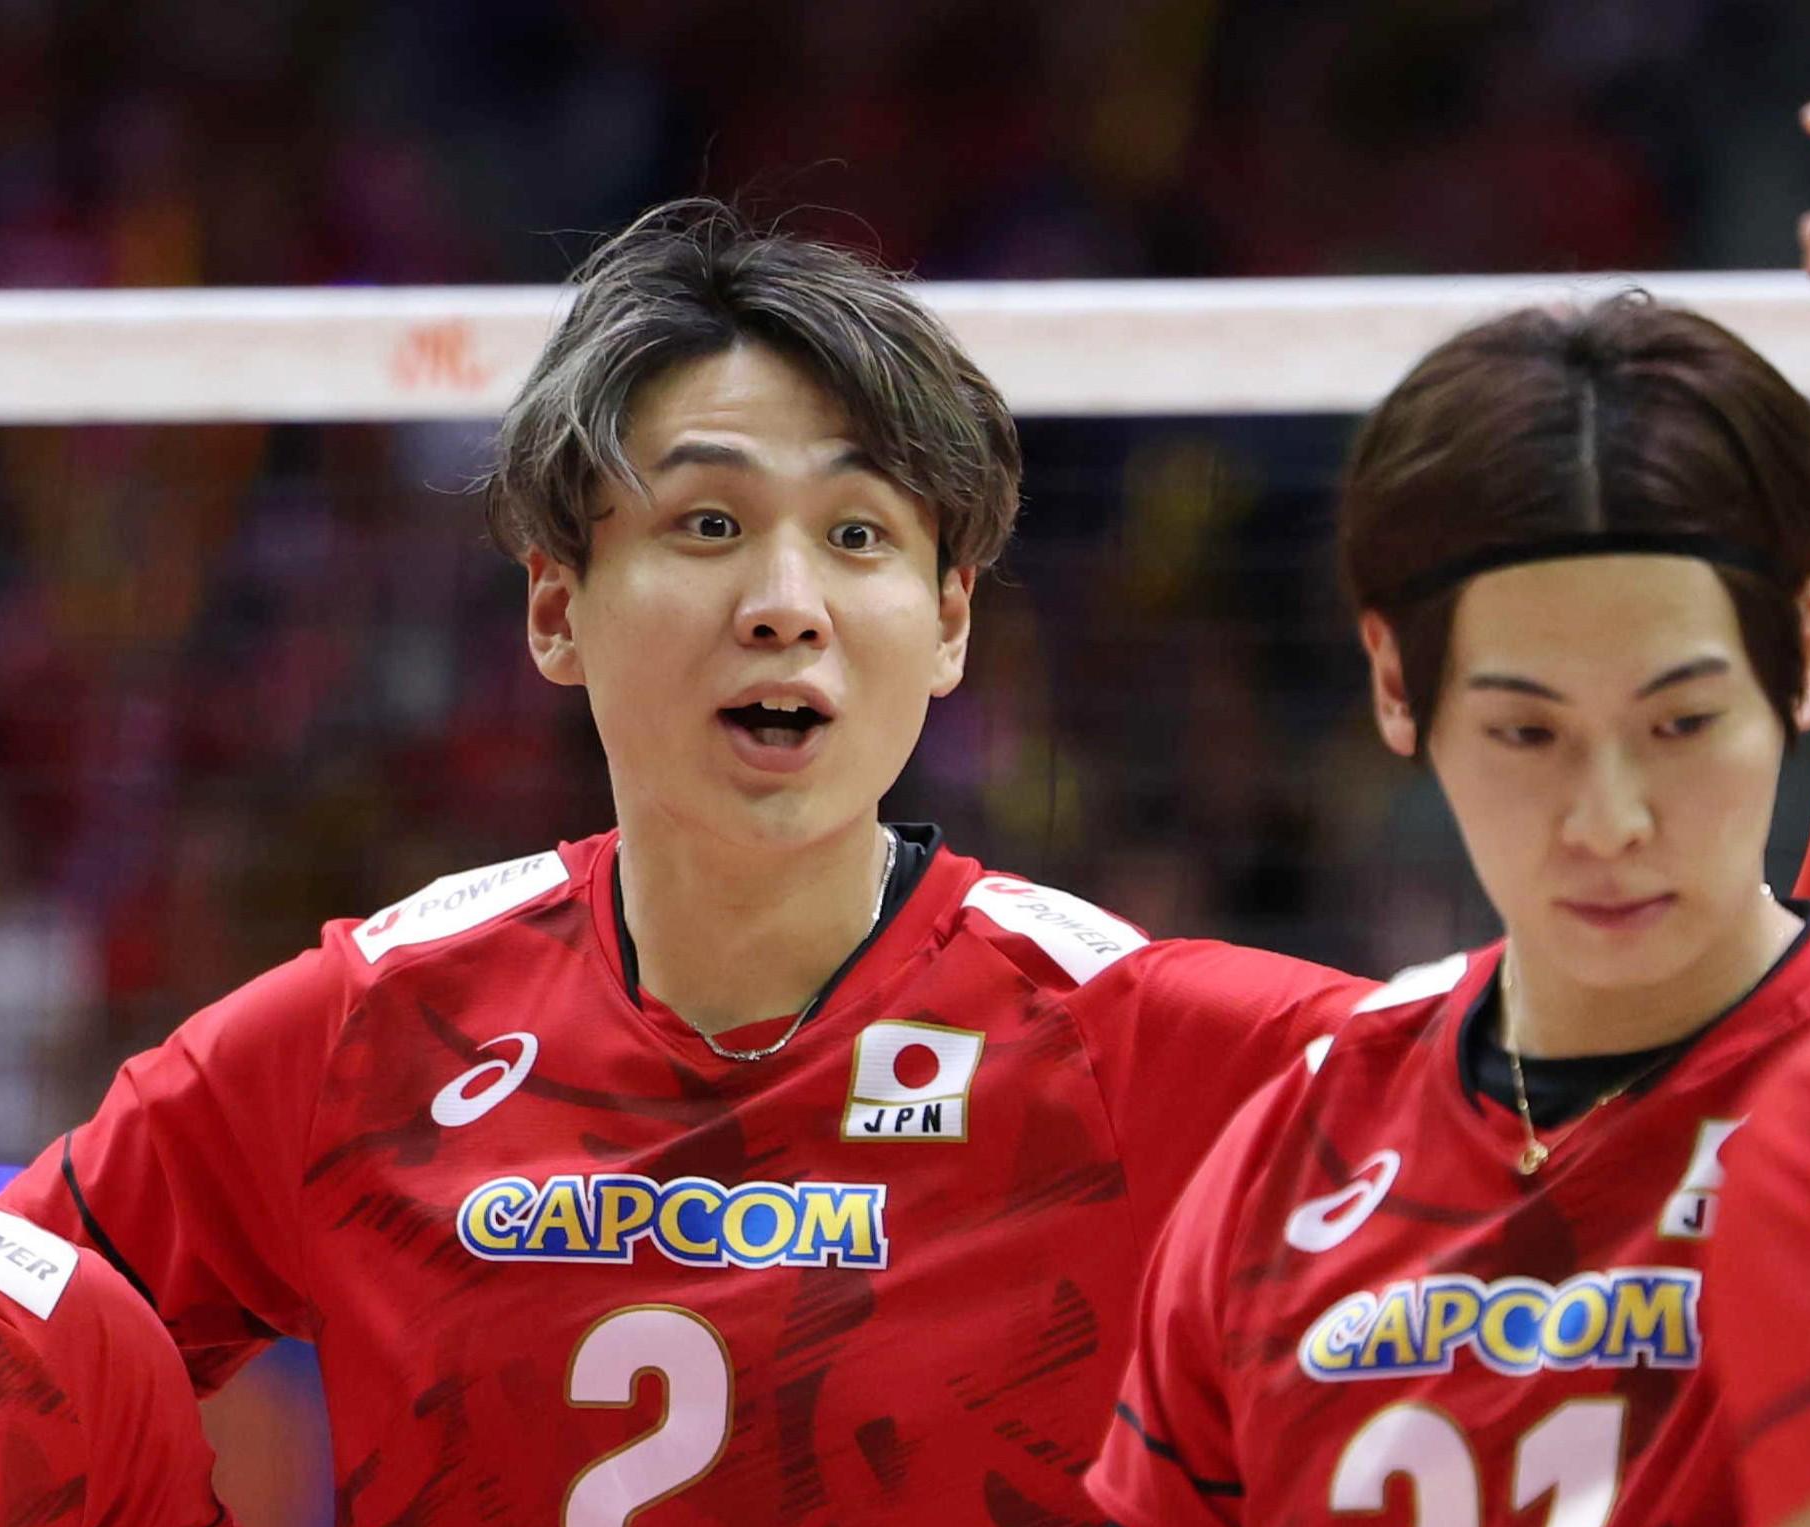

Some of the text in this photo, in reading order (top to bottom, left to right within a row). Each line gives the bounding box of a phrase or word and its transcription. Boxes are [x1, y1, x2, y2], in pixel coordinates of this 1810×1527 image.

[418, 857, 544, 918] POWER
[1017, 902, 1122, 955] POWER
[864, 1103, 942, 1133] JPN
[460, 1178, 884, 1266] CAPCOM
[1301, 1271, 1697, 1377] CAPCOM
